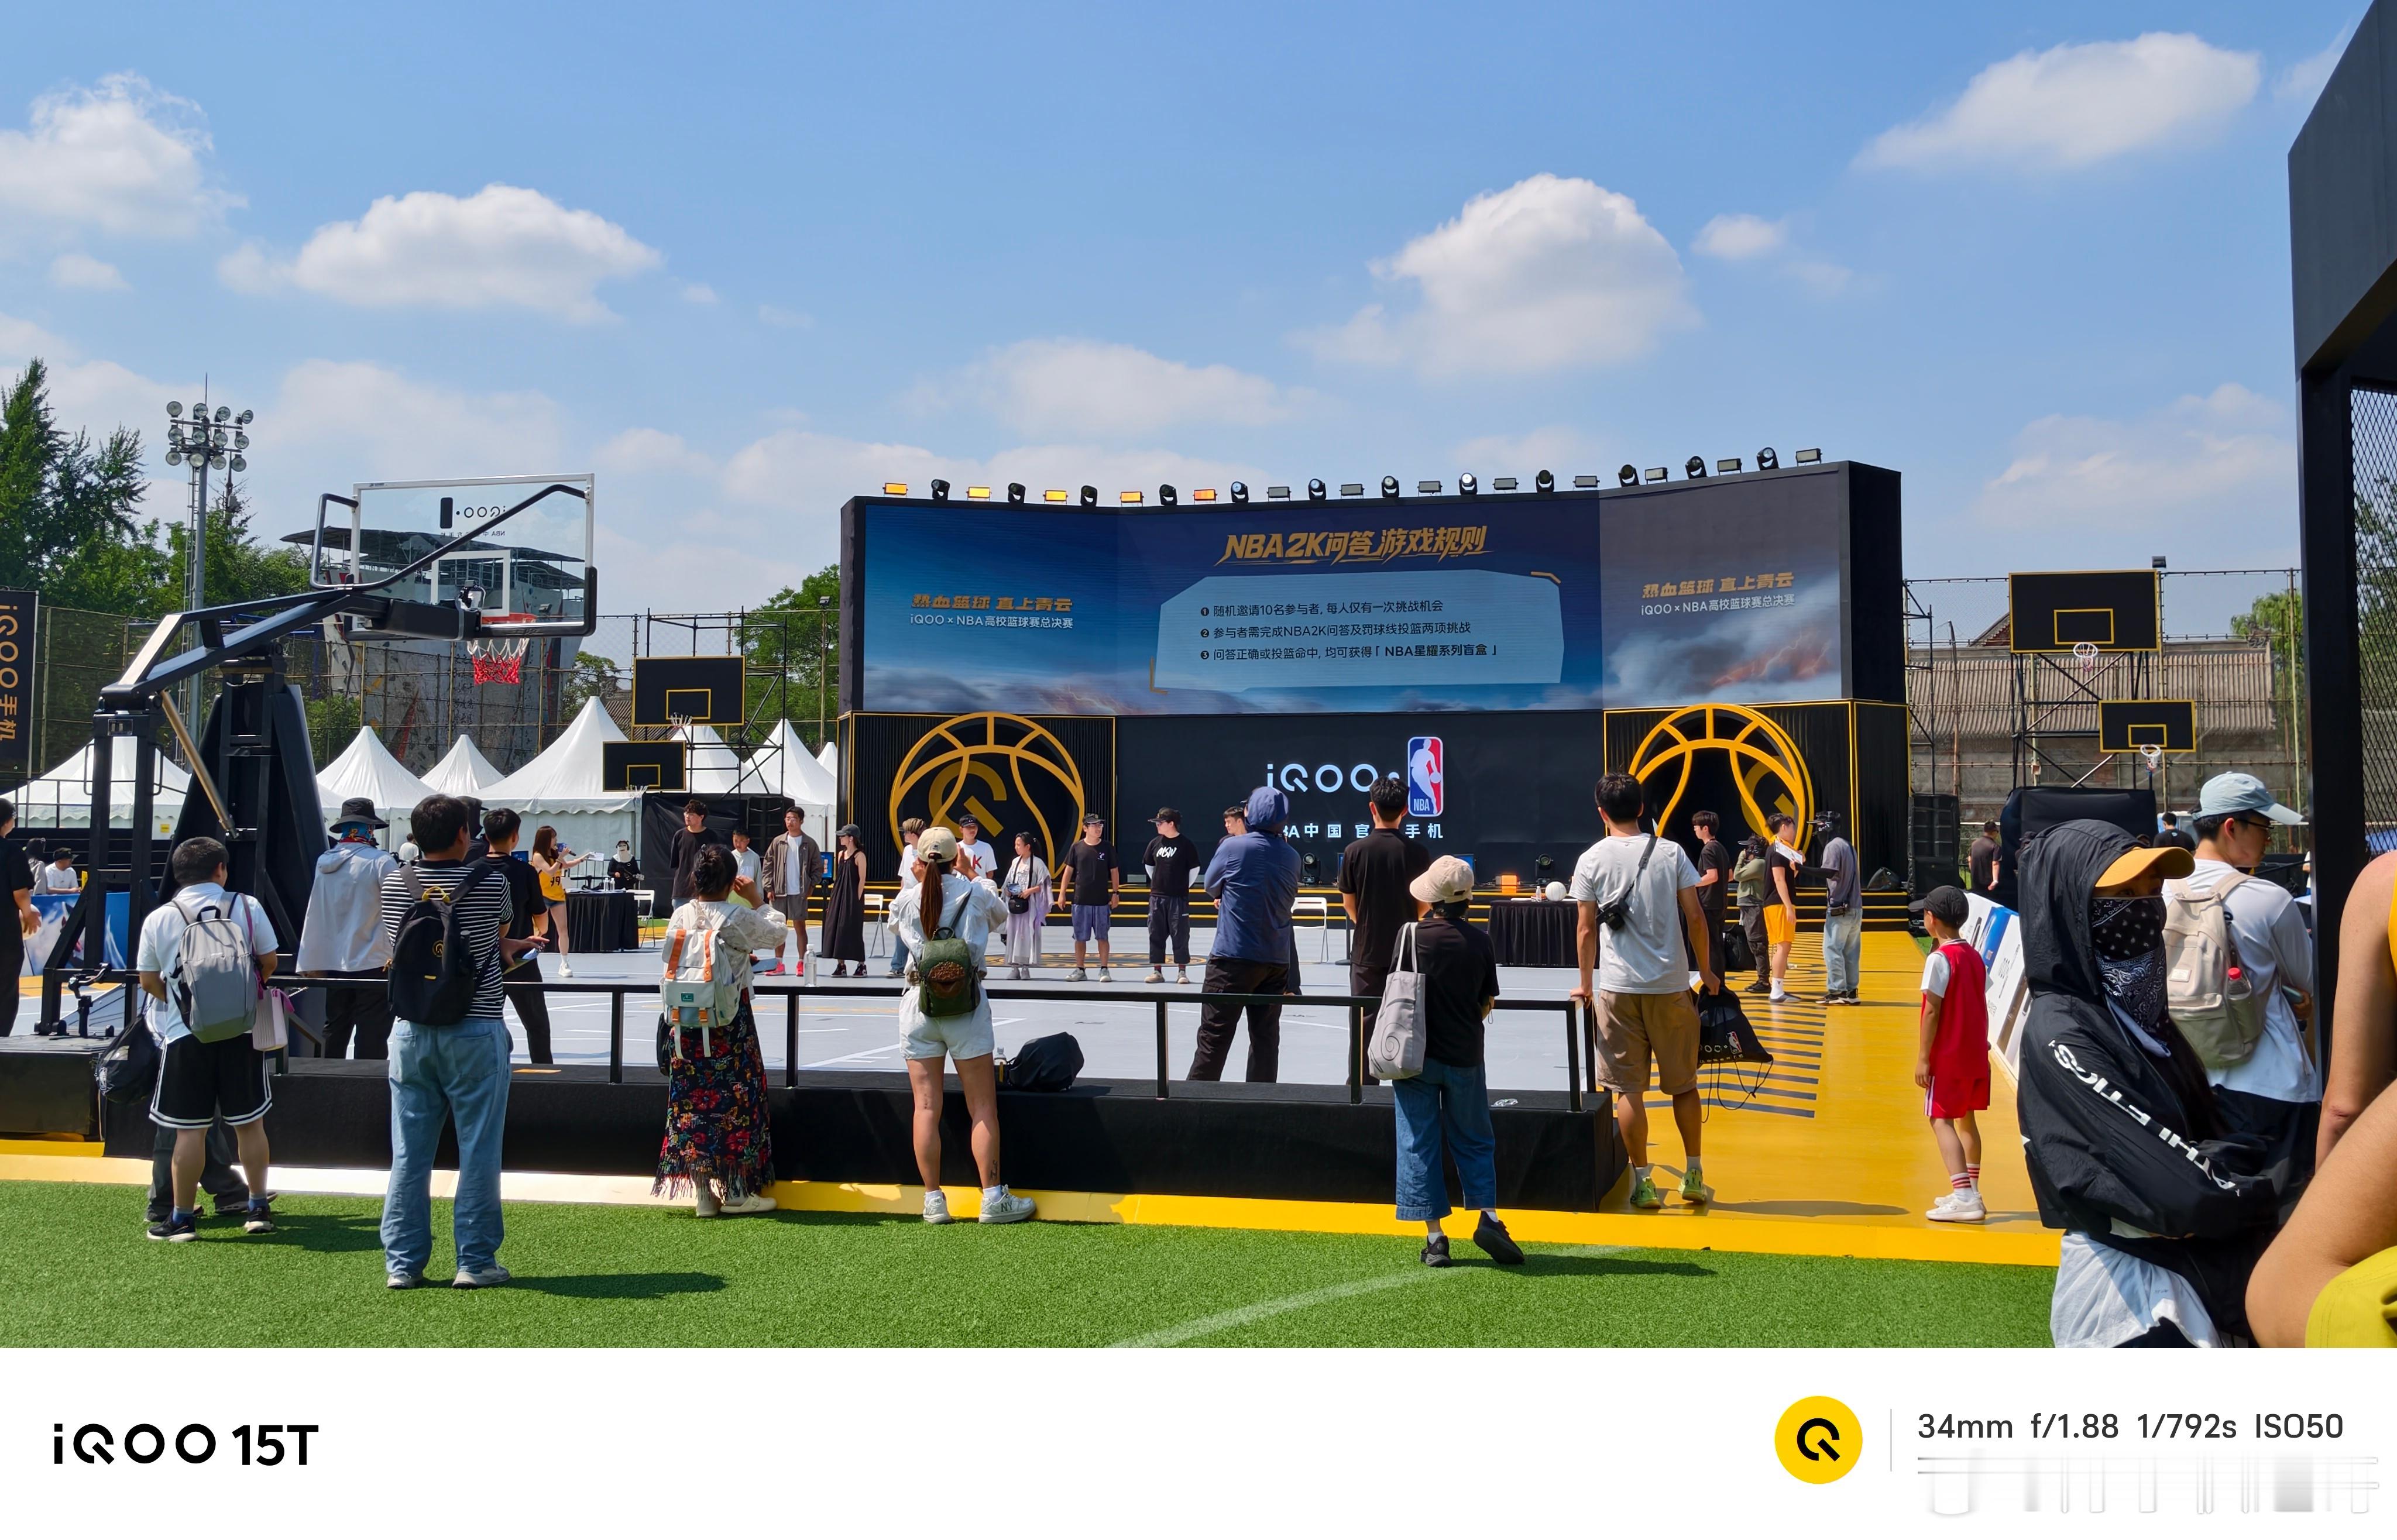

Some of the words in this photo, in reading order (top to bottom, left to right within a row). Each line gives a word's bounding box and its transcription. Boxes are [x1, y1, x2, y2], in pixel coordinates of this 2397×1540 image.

[1643, 578, 1714, 599] 热血篮球
[1719, 572, 1794, 592] 直上青云
[912, 593, 990, 609] 热血篮球
[995, 597, 1073, 611] 直上青云
[1641, 603, 1671, 615] iQOO
[911, 614, 944, 625] iQOO
[1267, 763, 1378, 793] iQOO
[1413, 798, 1430, 812] NBA
